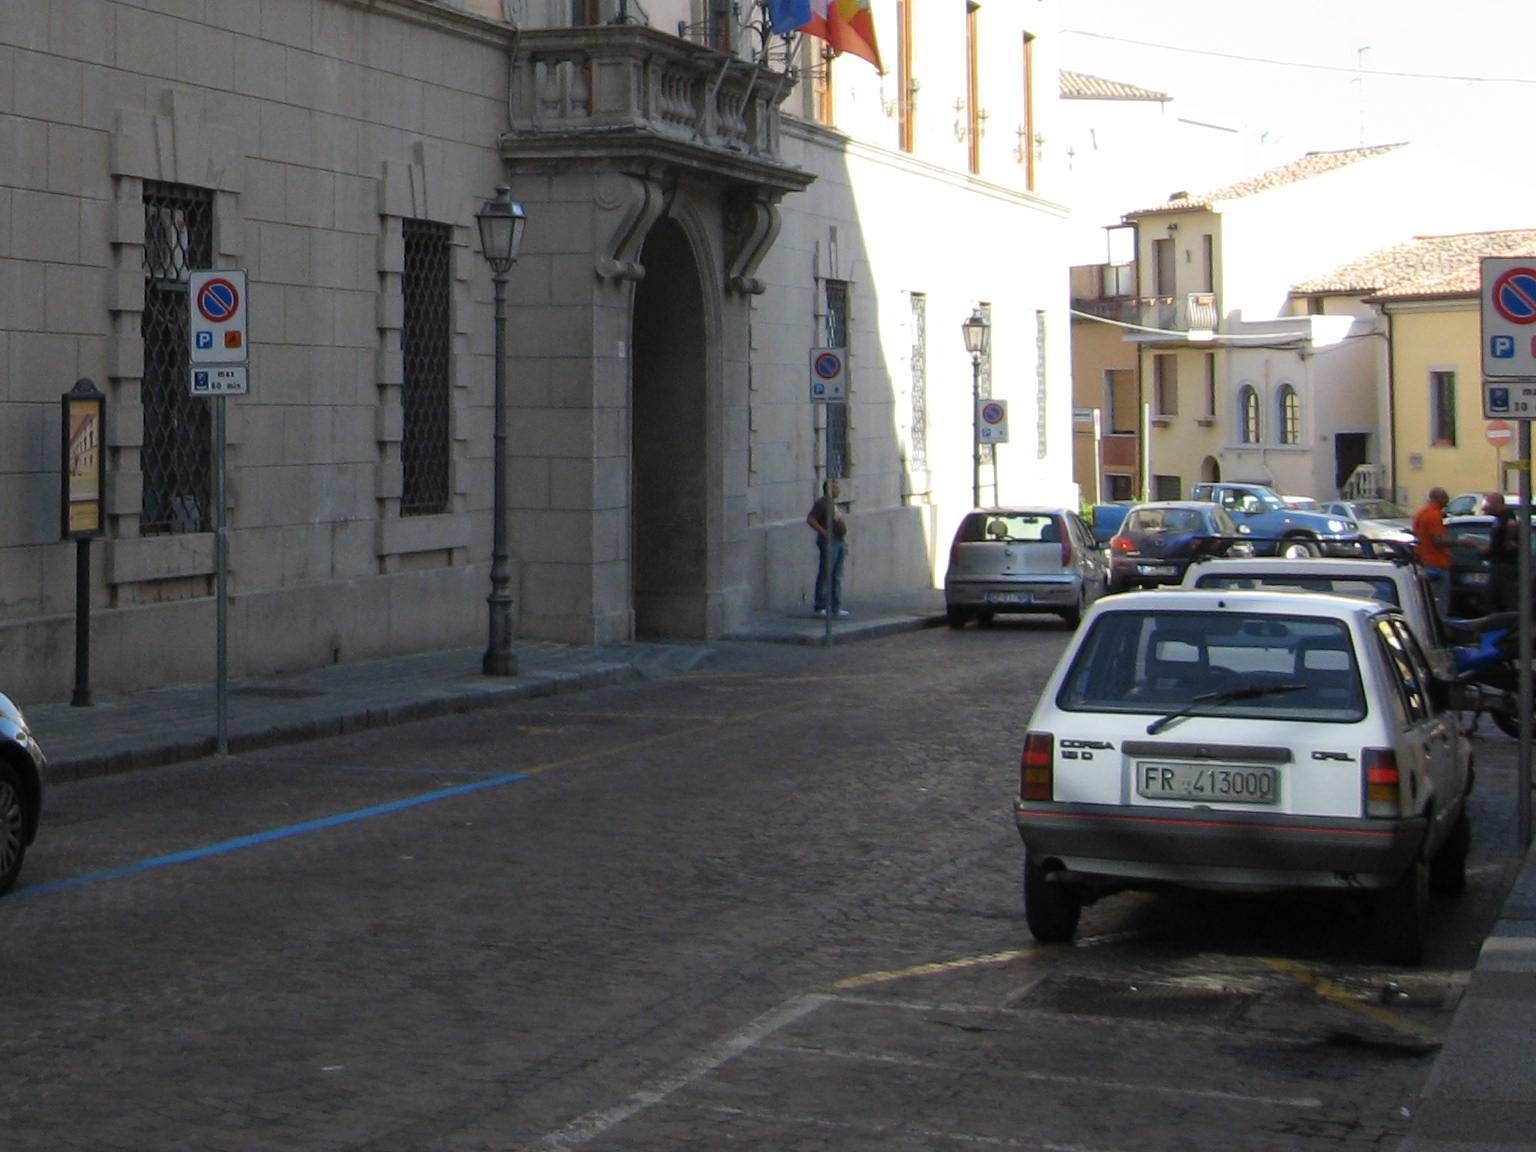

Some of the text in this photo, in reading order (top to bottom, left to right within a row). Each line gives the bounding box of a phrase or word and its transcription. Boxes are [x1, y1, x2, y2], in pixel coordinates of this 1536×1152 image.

[199, 333, 211, 348] P
[1496, 337, 1511, 356] P
[1060, 739, 1115, 750] CORSA
[1311, 751, 1356, 762] OPEL
[1145, 767, 1272, 795] FR 413000
